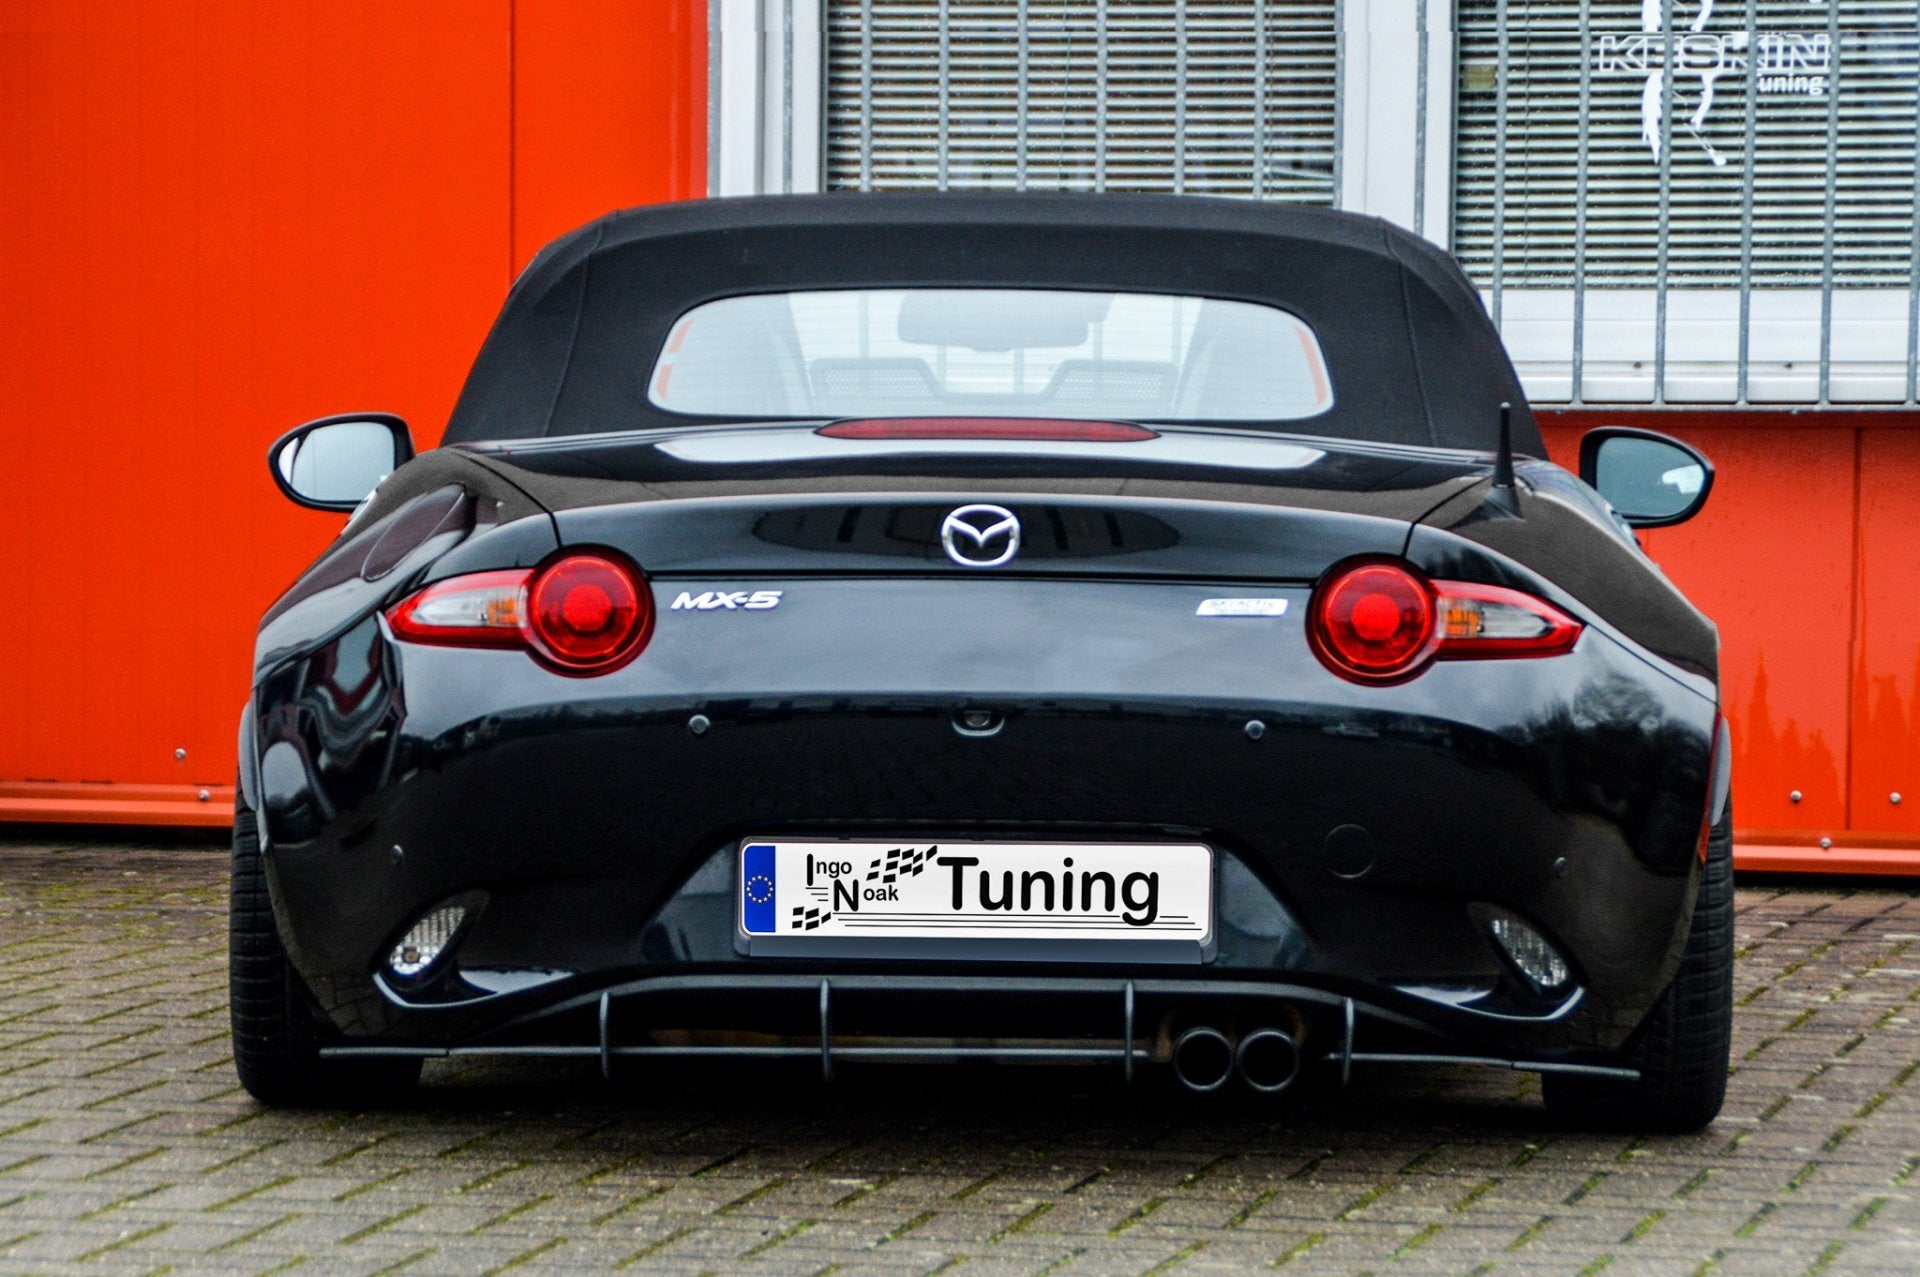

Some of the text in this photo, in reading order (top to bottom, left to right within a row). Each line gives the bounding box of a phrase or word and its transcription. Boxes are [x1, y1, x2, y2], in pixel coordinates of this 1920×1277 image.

[1750, 72, 1824, 96] uning
[670, 591, 783, 610] MX-5
[807, 854, 853, 886] Ingo
[834, 879, 900, 912] Noak
[936, 857, 1160, 926] Tuning
